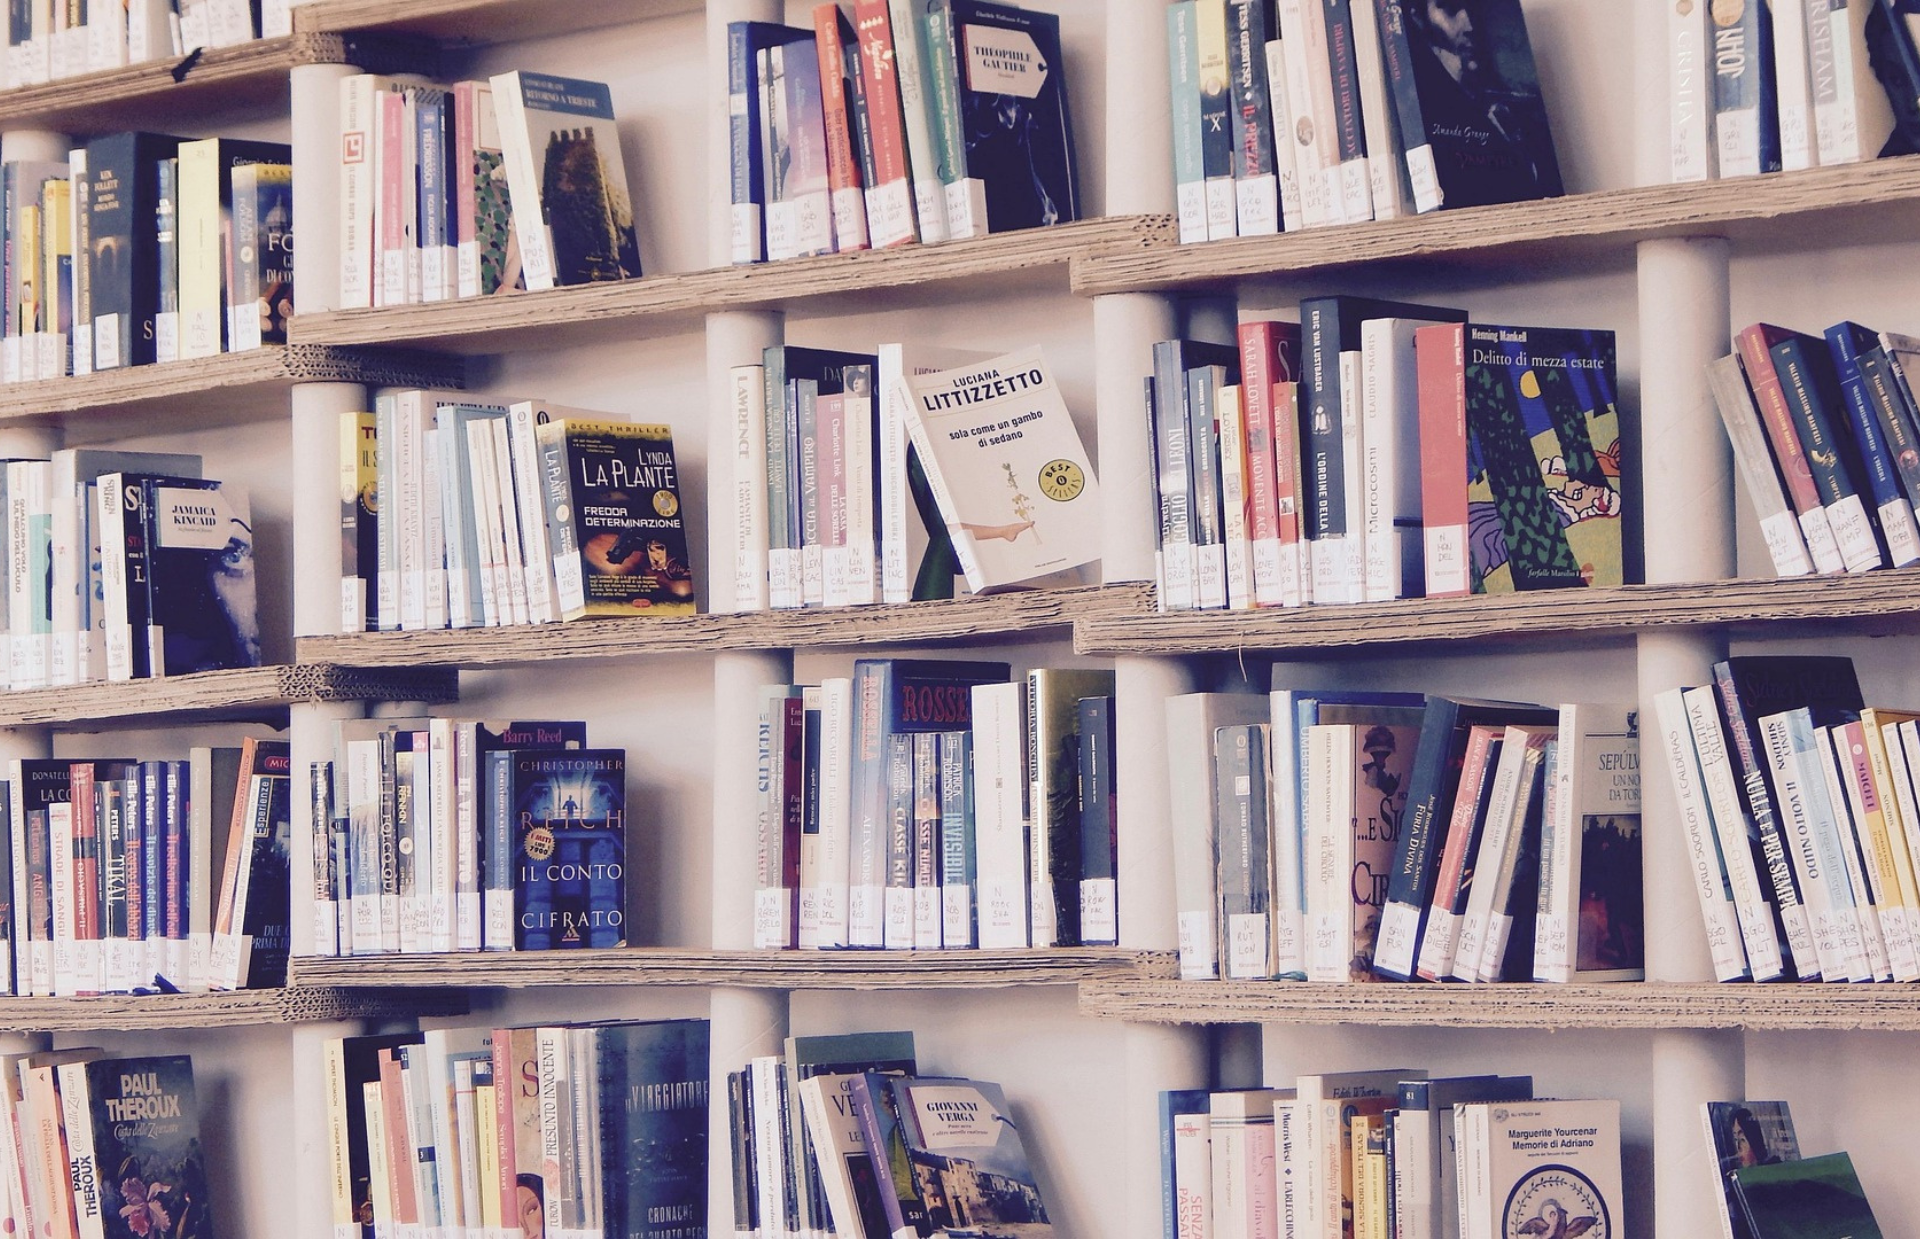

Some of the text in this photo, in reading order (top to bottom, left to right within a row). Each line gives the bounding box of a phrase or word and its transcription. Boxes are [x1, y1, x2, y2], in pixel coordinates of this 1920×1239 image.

[1239, 4, 1248, 29] TESS
[983, 59, 1026, 72] GAUTIER
[1240, 32, 1252, 88] GERRITSEN
[1716, 27, 1745, 79] JOHN
[1812, 0, 1834, 97] RISHAM
[1334, 23, 1356, 154] ACCIATORI DI VAMPIRI
[1243, 104, 1254, 119] IL
[1471, 329, 1527, 343] Henning Mankell
[1244, 339, 1256, 379] SARAH
[1473, 349, 1604, 370] Delitto di mezza estate
[923, 368, 1043, 412] LITTIZZETTO
[953, 369, 1000, 387] LUCIANA
[738, 376, 748, 459] LAWRENCE
[1248, 386, 1260, 425] LOVETT
[1312, 310, 1328, 530] ERIC VAN LUSTBADER L'ORDINE DELLA
[1788, 361, 1822, 445] VALERIO MASSIMO MANFREDI
[571, 423, 670, 434] BEST THRILLER
[950, 409, 1043, 440] sola come un gambo
[978, 430, 1023, 448] di sedano
[638, 448, 672, 465] LYNDA
[832, 418, 841, 477] Charlotte Link
[545, 450, 562, 503] LA PLANTE
[582, 458, 675, 488] LA PLANTE
[1045, 464, 1070, 478] BEST
[1254, 456, 1264, 511] MOVENTE
[172, 505, 216, 516] JAMAICA
[174, 516, 216, 526] KINCAID
[584, 507, 628, 516] FREDDA
[585, 517, 681, 528] DETERMINAZIONE
[831, 484, 840, 544] DELLE SORELLE
[503, 729, 562, 744] Barry Reed
[1691, 704, 1714, 767] L'ULTIMA
[1717, 678, 1752, 767] Sidney Sheldon
[1776, 721, 1792, 758] SIDNEY
[460, 731, 468, 756] Reed
[1706, 720, 1724, 762] VALLE
[1767, 723, 1785, 770] SHELDON
[520, 760, 623, 772] CHRISTOPHER
[943, 758, 952, 802] ROBINSON
[952, 762, 961, 796] PATRICK
[41, 789, 54, 801] LA
[145, 775, 155, 825] Ellis Peters
[167, 774, 176, 824] Ellis Peters
[458, 777, 470, 795] IL
[1681, 790, 1691, 798] IL
[1742, 770, 1774, 820] NULLA
[127, 780, 137, 830] Ellis Peters
[255, 782, 269, 836] Esperienze
[398, 785, 407, 823] RANKIN
[521, 810, 622, 830] REICH
[1403, 804, 1426, 875] FURIA DIVINA
[1686, 807, 1705, 858] SGORLON
[1759, 831, 1786, 859] PER
[1785, 781, 1819, 879] IL VOLTO NUDO
[945, 812, 964, 884] INVISIBIL
[55, 832, 66, 937] STRADE DI SANGU
[107, 855, 125, 905] TIKAL
[521, 864, 622, 881] IL CONTO
[1412, 865, 1422, 891] SANTOS
[1698, 862, 1714, 899] CARLO
[1767, 861, 1797, 911] SEMPR
[521, 911, 622, 928] CIFRATO
[495, 1043, 503, 1076] Joanna
[542, 1039, 554, 1098] INNOCENTE
[121, 1073, 162, 1097] PAUL
[497, 1079, 506, 1113] Trollope
[105, 1096, 181, 1121] THEROUX
[927, 1102, 978, 1111] GIOVANNI
[938, 1113, 974, 1121] VERGA
[498, 1124, 507, 1160] Semplici
[545, 1102, 557, 1156] PRESUNTO
[1283, 1113, 1291, 1140] Morris
[1508, 1128, 1597, 1140] Marguerite Yourcenar
[1283, 1143, 1292, 1161] West
[1513, 1139, 1594, 1150] Memorie di Adriano
[72, 1157, 82, 1191] PAUL
[80, 1155, 97, 1217] THEROUX
